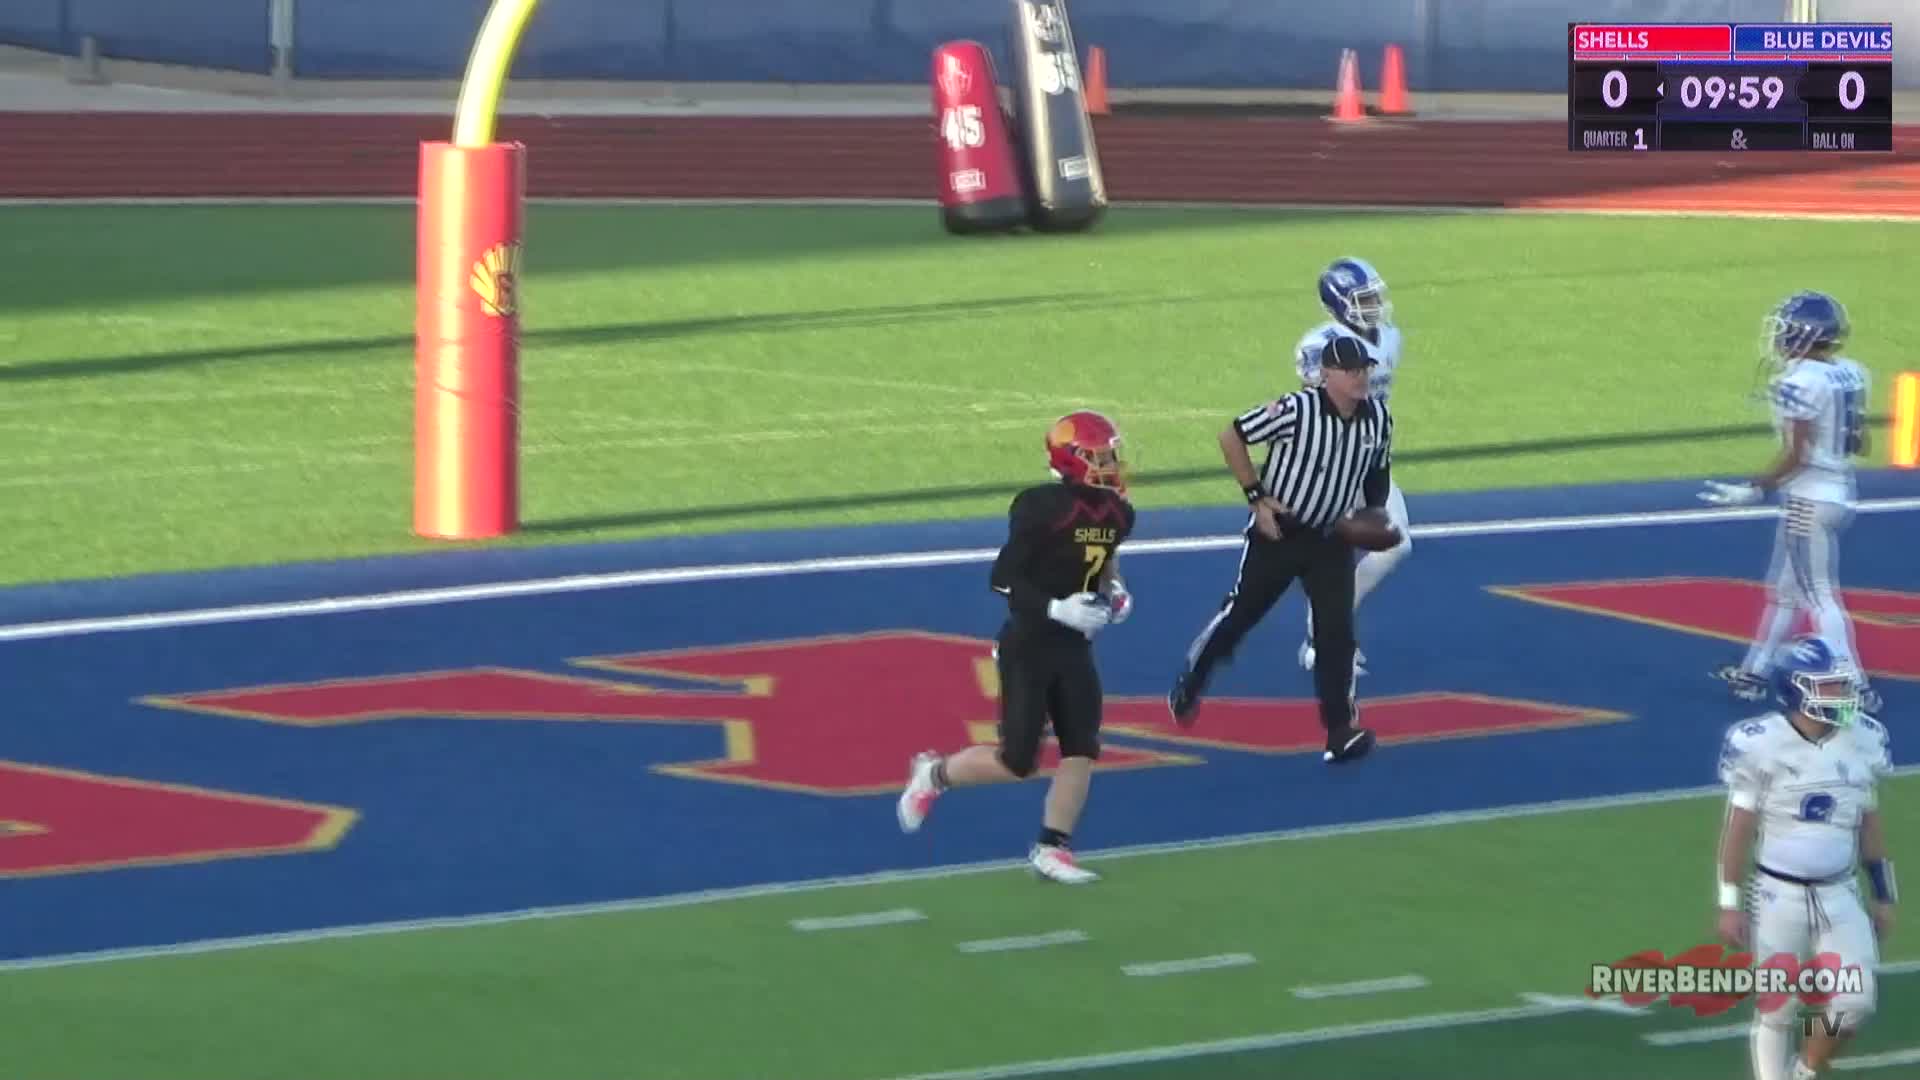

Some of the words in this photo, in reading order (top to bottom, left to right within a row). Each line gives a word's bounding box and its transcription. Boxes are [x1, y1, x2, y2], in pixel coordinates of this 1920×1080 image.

[941, 104, 985, 150] 45
[1074, 527, 1116, 543] SHELLS
[1083, 545, 1108, 592] 7
